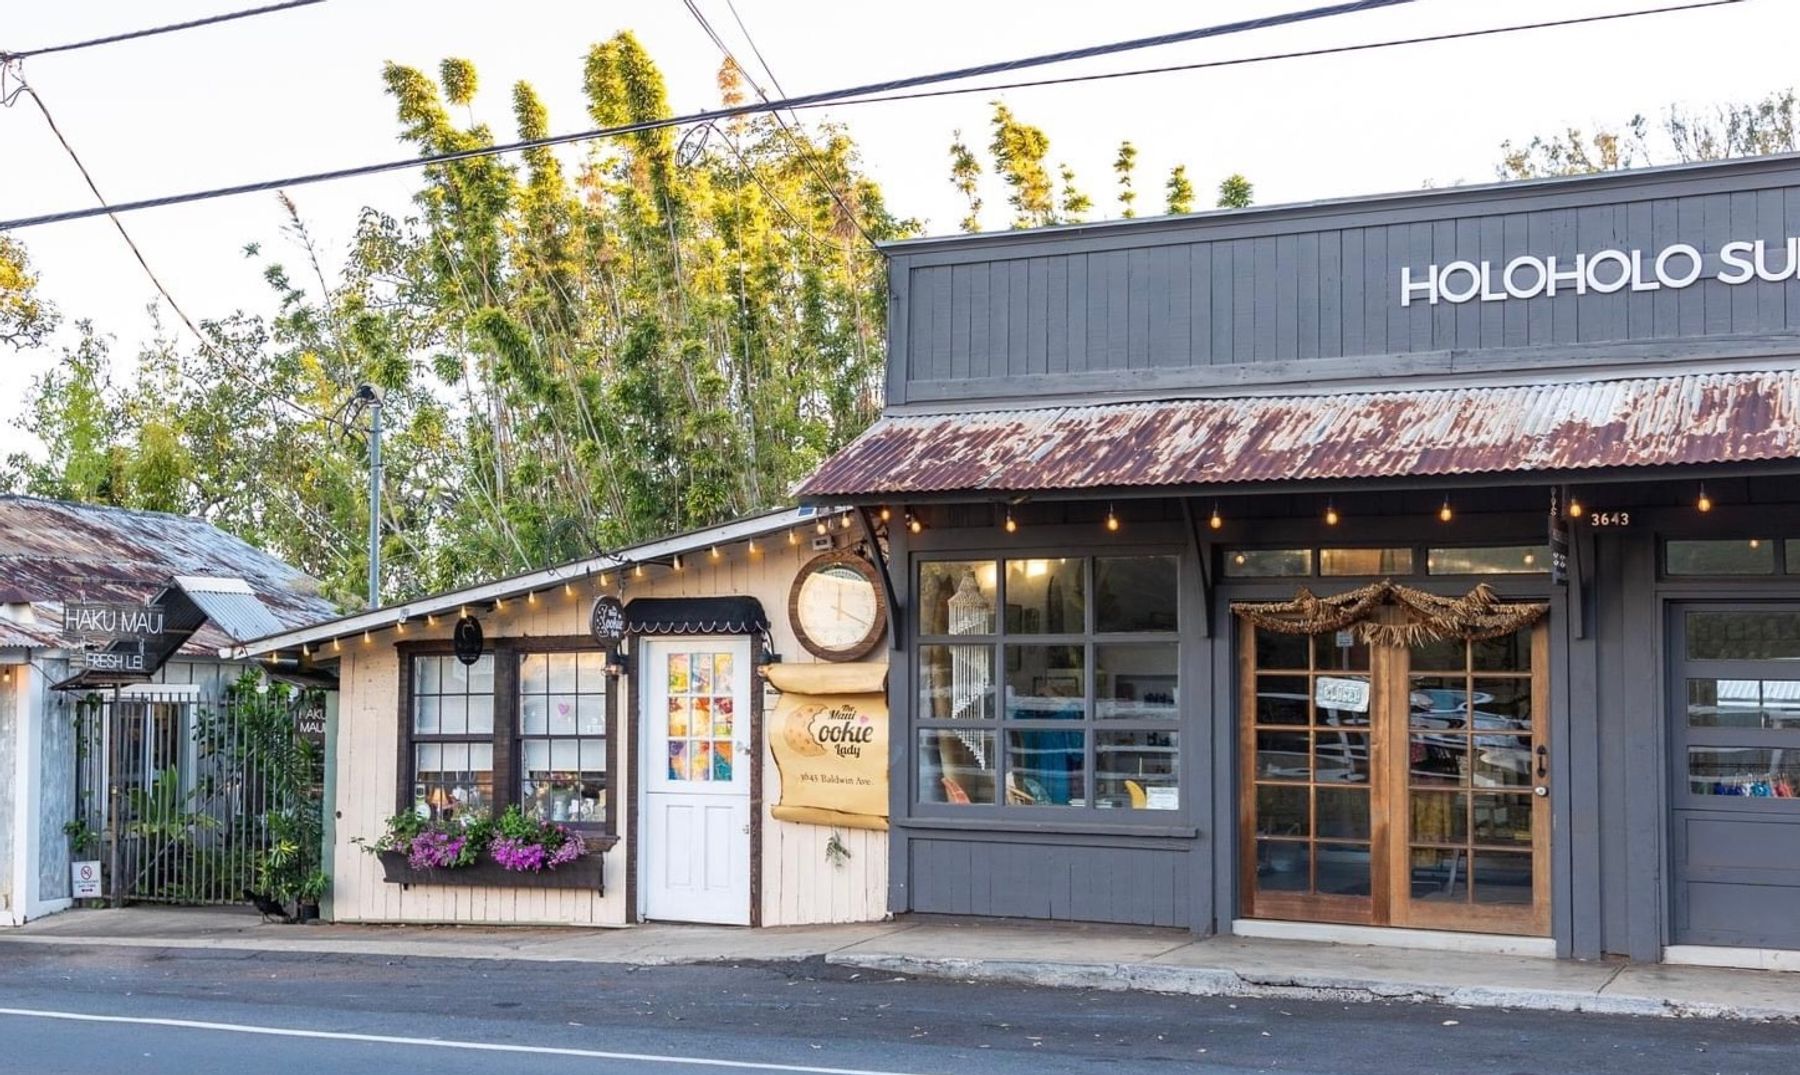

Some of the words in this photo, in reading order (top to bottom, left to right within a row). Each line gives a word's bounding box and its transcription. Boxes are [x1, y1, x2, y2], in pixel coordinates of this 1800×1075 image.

[1401, 243, 1702, 306] HOLOHOLO
[1717, 237, 1800, 285] SU
[1591, 512, 1630, 526] 3643
[65, 608, 116, 632] HAKU
[121, 611, 163, 634] MAUI
[85, 652, 123, 669] FRESH
[126, 655, 143, 669] LEI
[829, 709, 857, 720] Maui
[834, 743, 861, 758] Lady
[820, 774, 853, 785] Baldwin
